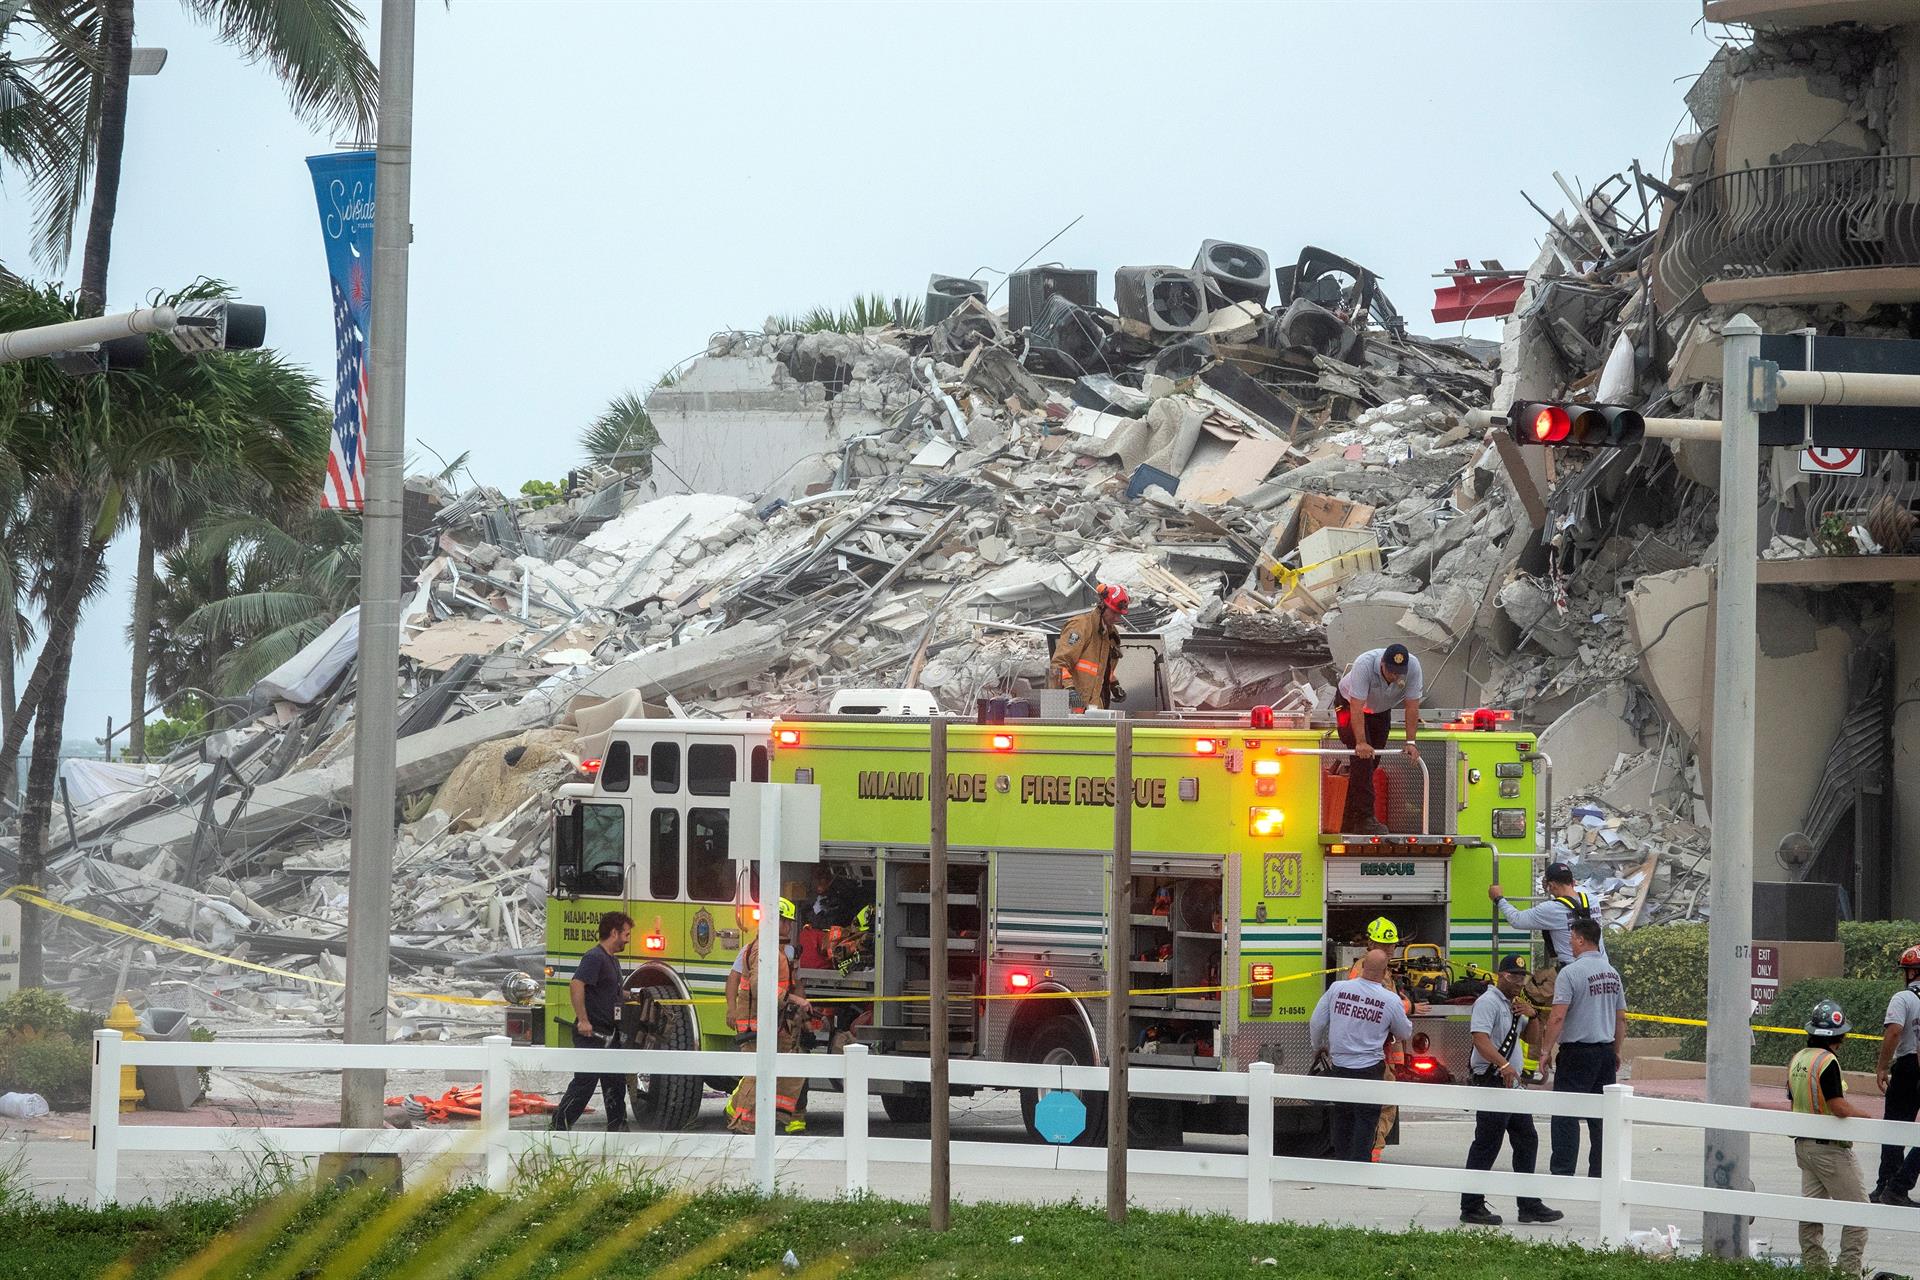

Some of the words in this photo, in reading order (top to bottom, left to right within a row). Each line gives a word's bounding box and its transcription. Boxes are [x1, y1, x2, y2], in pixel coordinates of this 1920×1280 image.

[858, 770, 924, 801] MIAMI
[928, 772, 987, 802] ADE
[1021, 774, 1072, 805] FIRE
[1075, 776, 1167, 808] RESUE
[1266, 857, 1298, 894] 69
[1360, 862, 1416, 876] RESCUE
[563, 928, 580, 941] FIRE
[581, 928, 600, 942] RESC
[1758, 949, 1771, 961] EXIT
[1757, 964, 1772, 976] ONLY
[1753, 988, 1763, 1000] DO
[1763, 988, 1776, 1000] NOT
[1279, 1006, 1306, 1015] 21-0545
[1334, 1001, 1352, 1016] FIRE
[1351, 1006, 1384, 1023] RESCUE
[1755, 1003, 1771, 1015] ENTE
